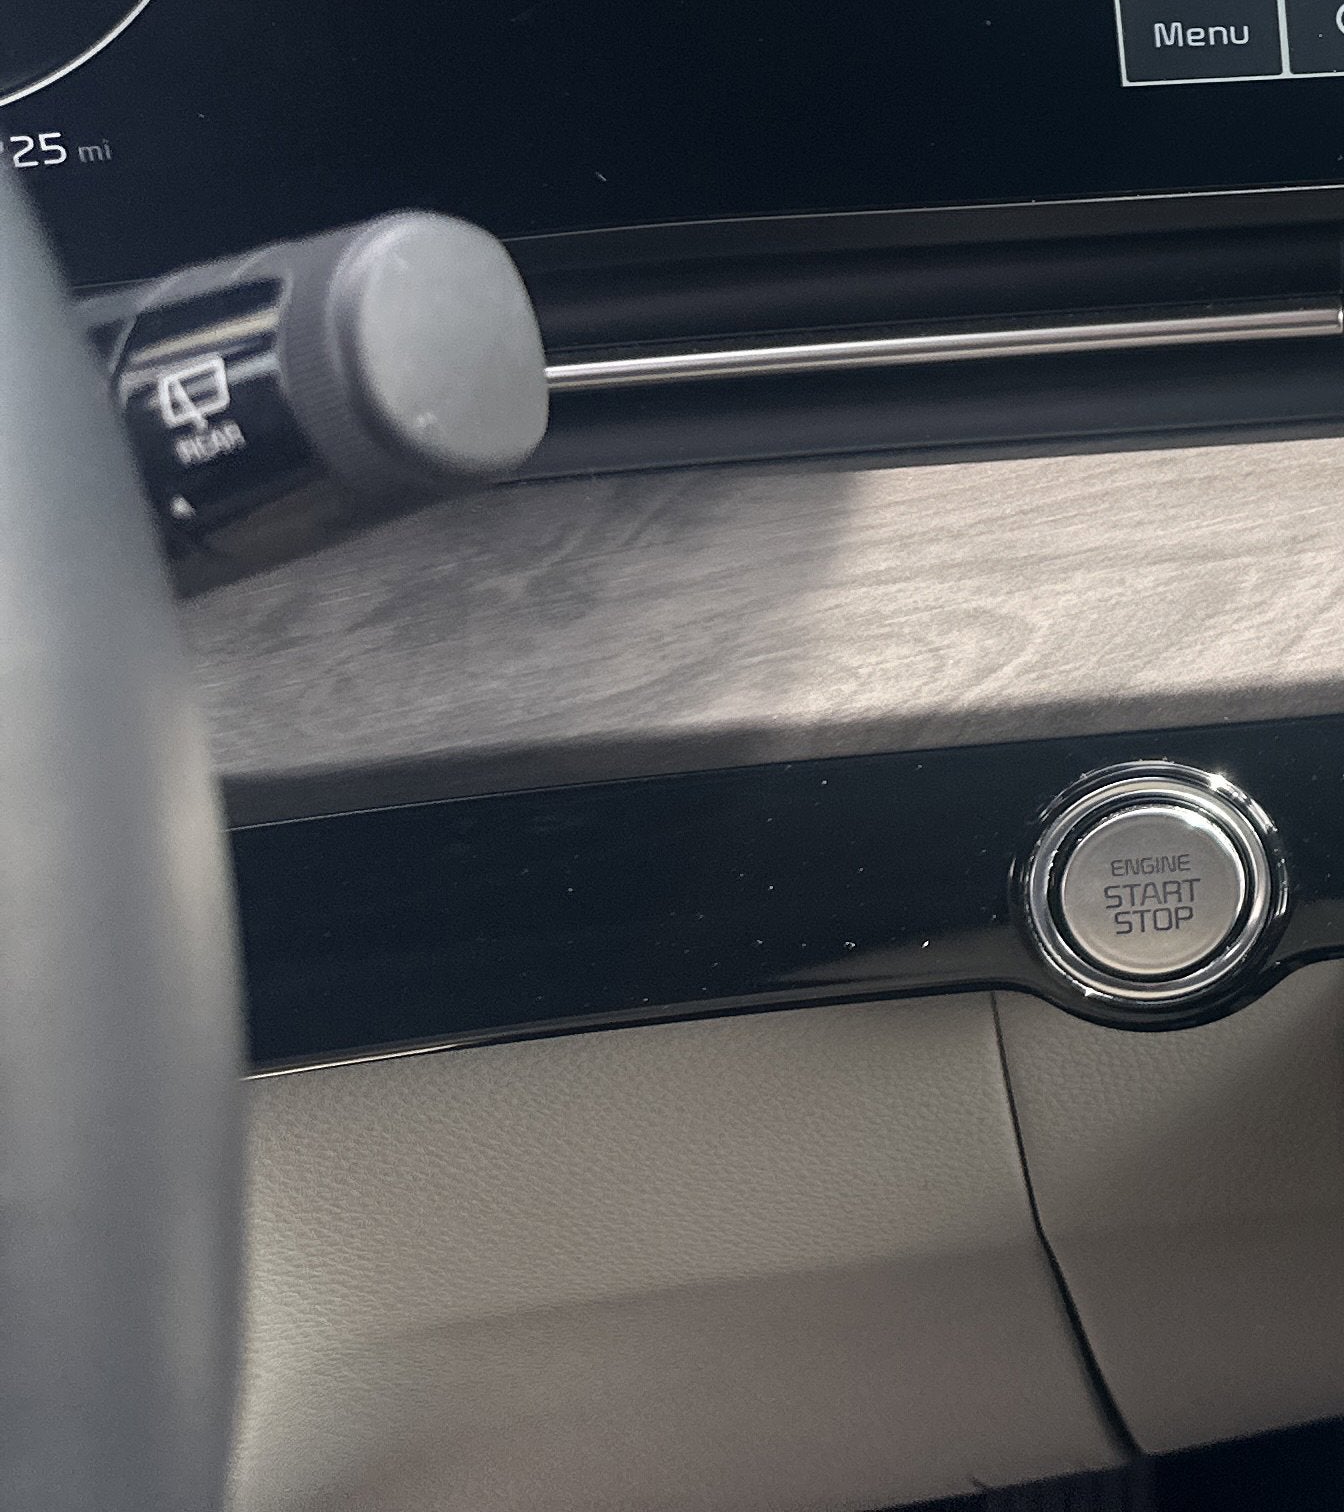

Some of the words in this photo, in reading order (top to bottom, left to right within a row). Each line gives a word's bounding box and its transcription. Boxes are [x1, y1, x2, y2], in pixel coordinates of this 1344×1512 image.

[1154, 22, 1249, 48] Menu
[0, 132, 67, 168] 25
[78, 139, 112, 163] mi
[1110, 853, 1191, 877] ENGINE
[1103, 877, 1202, 909] START
[1112, 905, 1194, 935] STOP
